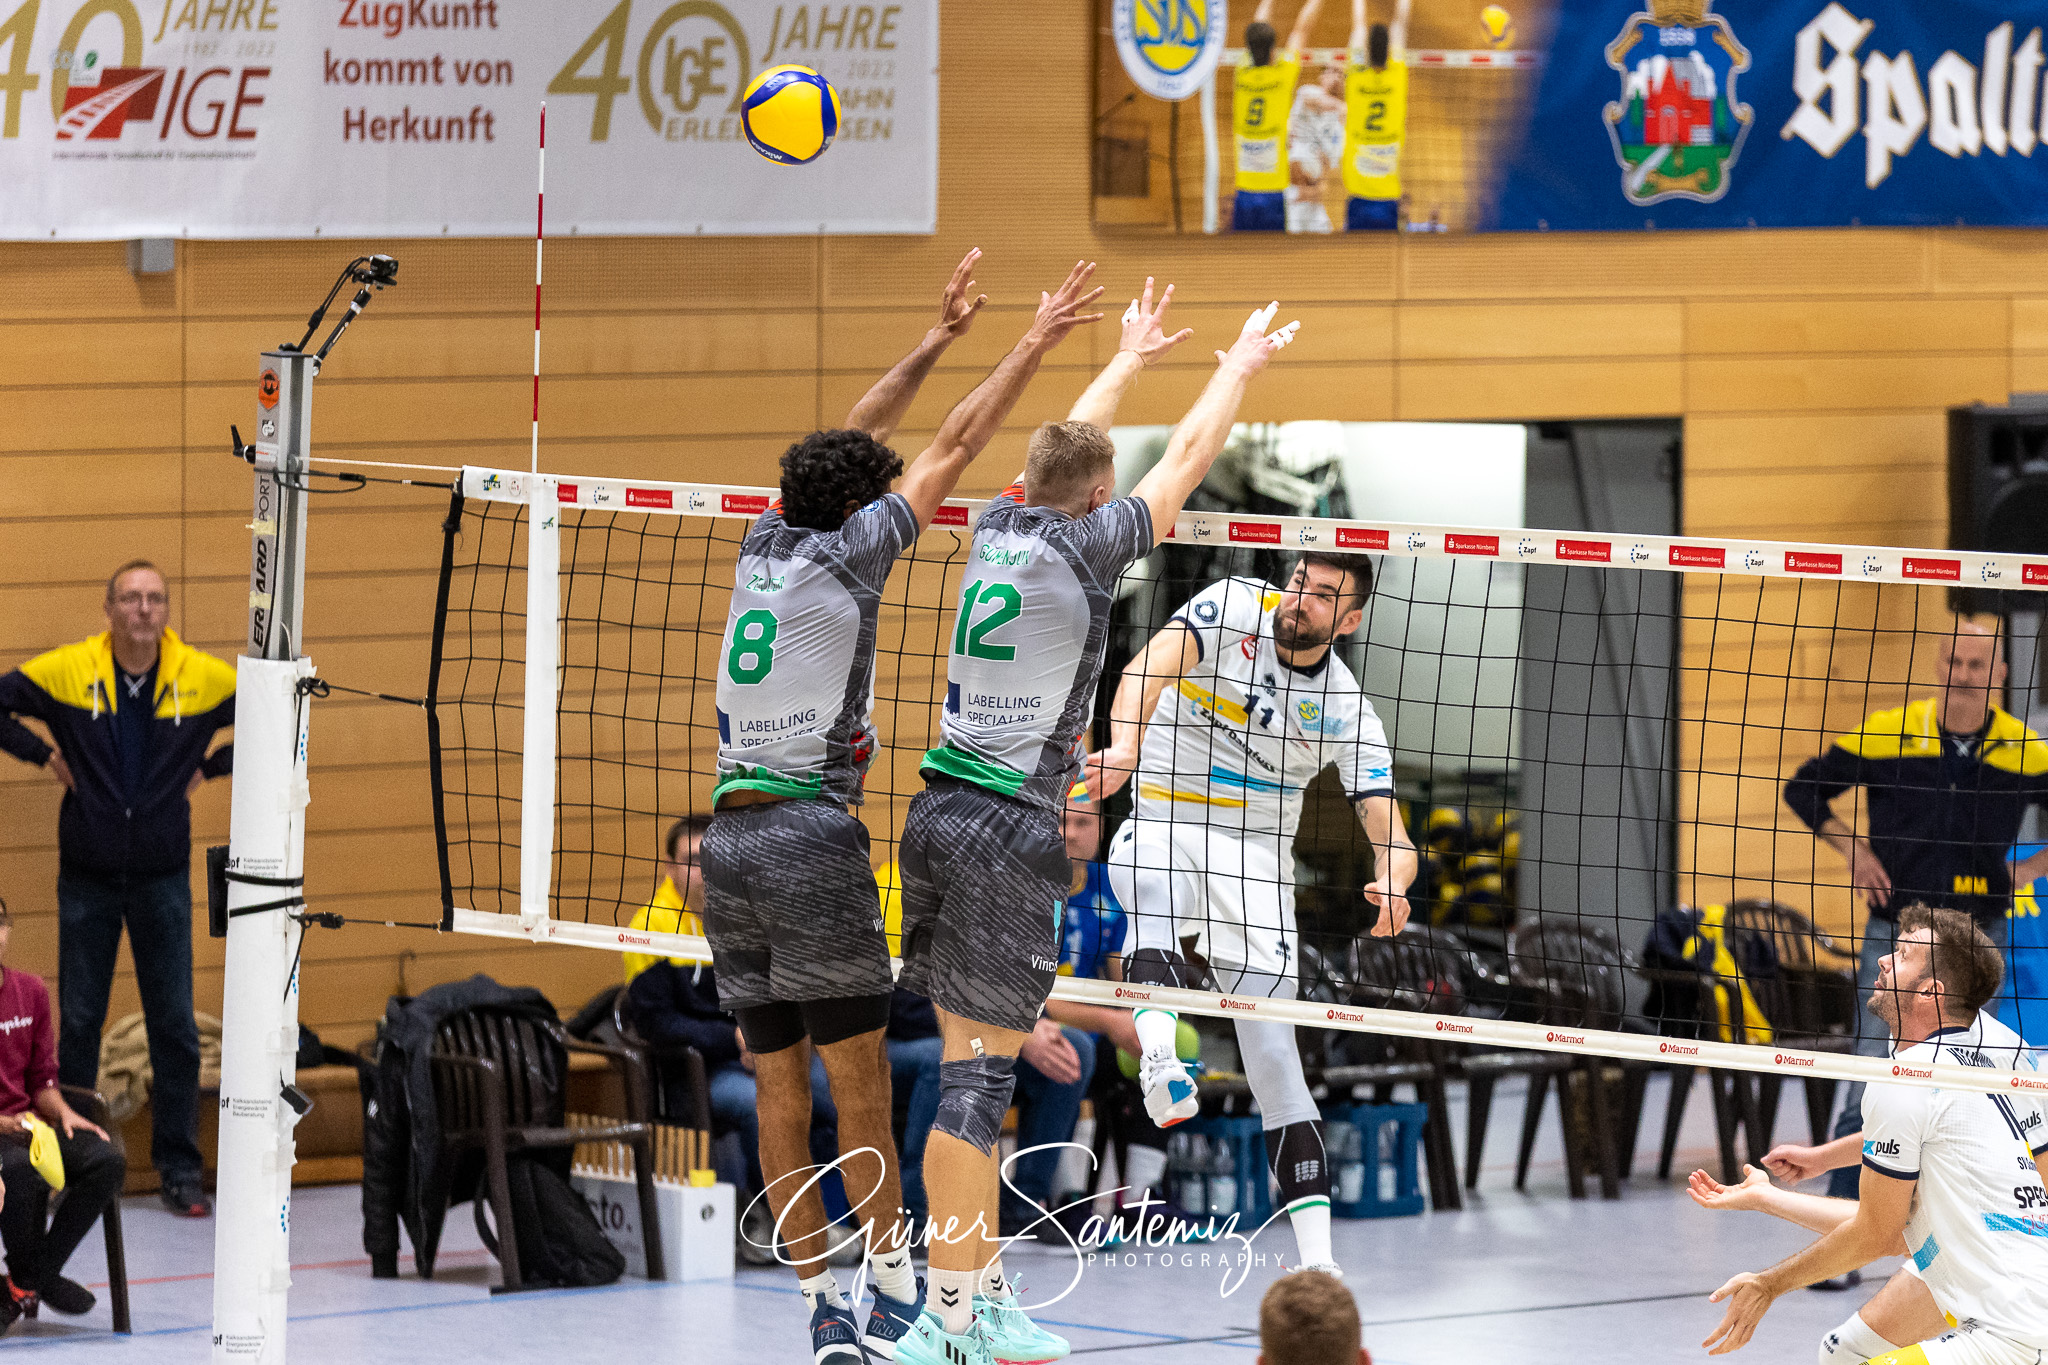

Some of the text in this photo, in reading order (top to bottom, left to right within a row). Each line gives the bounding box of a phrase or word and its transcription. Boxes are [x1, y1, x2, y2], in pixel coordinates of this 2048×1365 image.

[153, 0, 279, 43] JAHRE
[338, 0, 499, 38] ZugKunft
[761, 5, 901, 63] JAHRE
[323, 48, 514, 86] kommt von
[1780, 1, 2048, 190] Spalt
[158, 66, 272, 140] IGE
[1365, 101, 1386, 131] 2
[343, 104, 495, 142] Herkunft
[1198, 528, 1211, 537] Zapf
[1239, 530, 1278, 541] Sparkasse Nürnberg
[1304, 534, 1317, 543] Zapf
[1346, 536, 1386, 547] Sparkasse Nürnberg
[1412, 540, 1426, 550] Zapf
[1455, 542, 1496, 552] Sparkasse Nürnberg
[1523, 546, 1537, 555] Zapf
[1566, 549, 1608, 559] Sparkasse Nürnberg
[1635, 552, 1649, 561] Zapf
[1680, 554, 1722, 565] Sparkasse Nürnberg
[1750, 558, 1765, 568] Zapf
[1796, 560, 1839, 571] Sparkasse Nürnberg
[1868, 564, 1883, 574] Zapf
[1914, 567, 1958, 578] Sparkasse Nürnberg
[1987, 570, 2002, 580] Zapf
[953, 577, 1025, 663] 12
[727, 607, 779, 687] 8
[968, 692, 1042, 709] LABELLING
[739, 708, 817, 733] LABELLING
[625, 934, 651, 946] Marmot
[1123, 988, 1151, 1001] Marmot
[1227, 998, 1256, 1011] Marmot
[1334, 1010, 1364, 1023] Marmot
[1443, 1022, 1473, 1035] Marmot
[1554, 1033, 1585, 1046] Marmot
[1667, 1043, 1699, 1056] Marmot
[1782, 1054, 1815, 1067] Marmot
[1900, 1066, 1933, 1080] Marmot
[2020, 1079, 2048, 1090] Marmo
